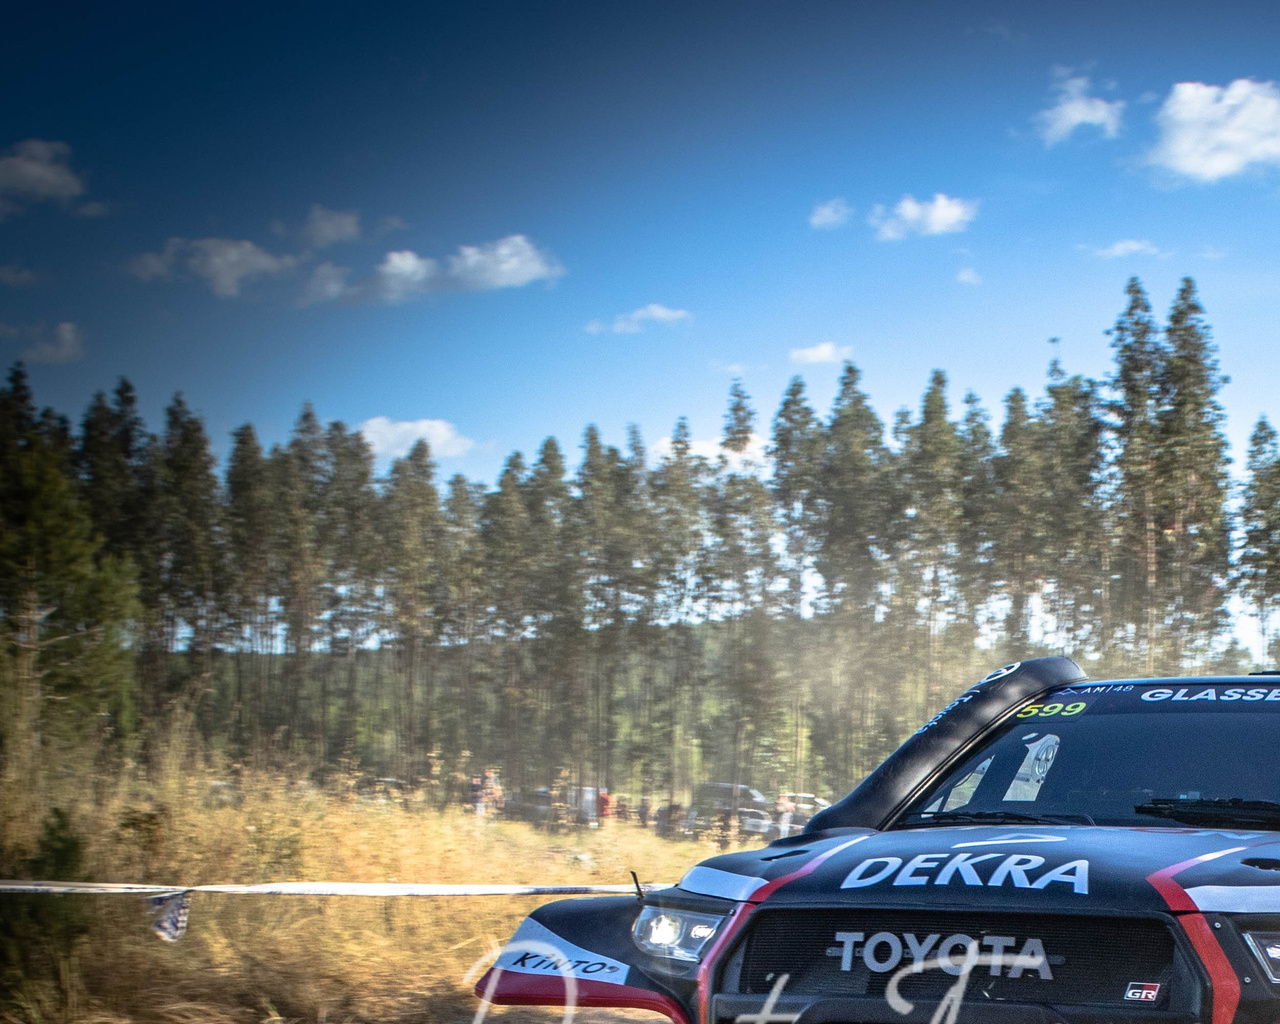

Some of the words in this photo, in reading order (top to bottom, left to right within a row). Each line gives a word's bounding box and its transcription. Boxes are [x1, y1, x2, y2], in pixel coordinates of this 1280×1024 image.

[1016, 701, 1087, 719] 599
[840, 852, 1090, 895] DEKRA
[835, 930, 1054, 981] TOYOTA
[1127, 989, 1156, 999] GR
